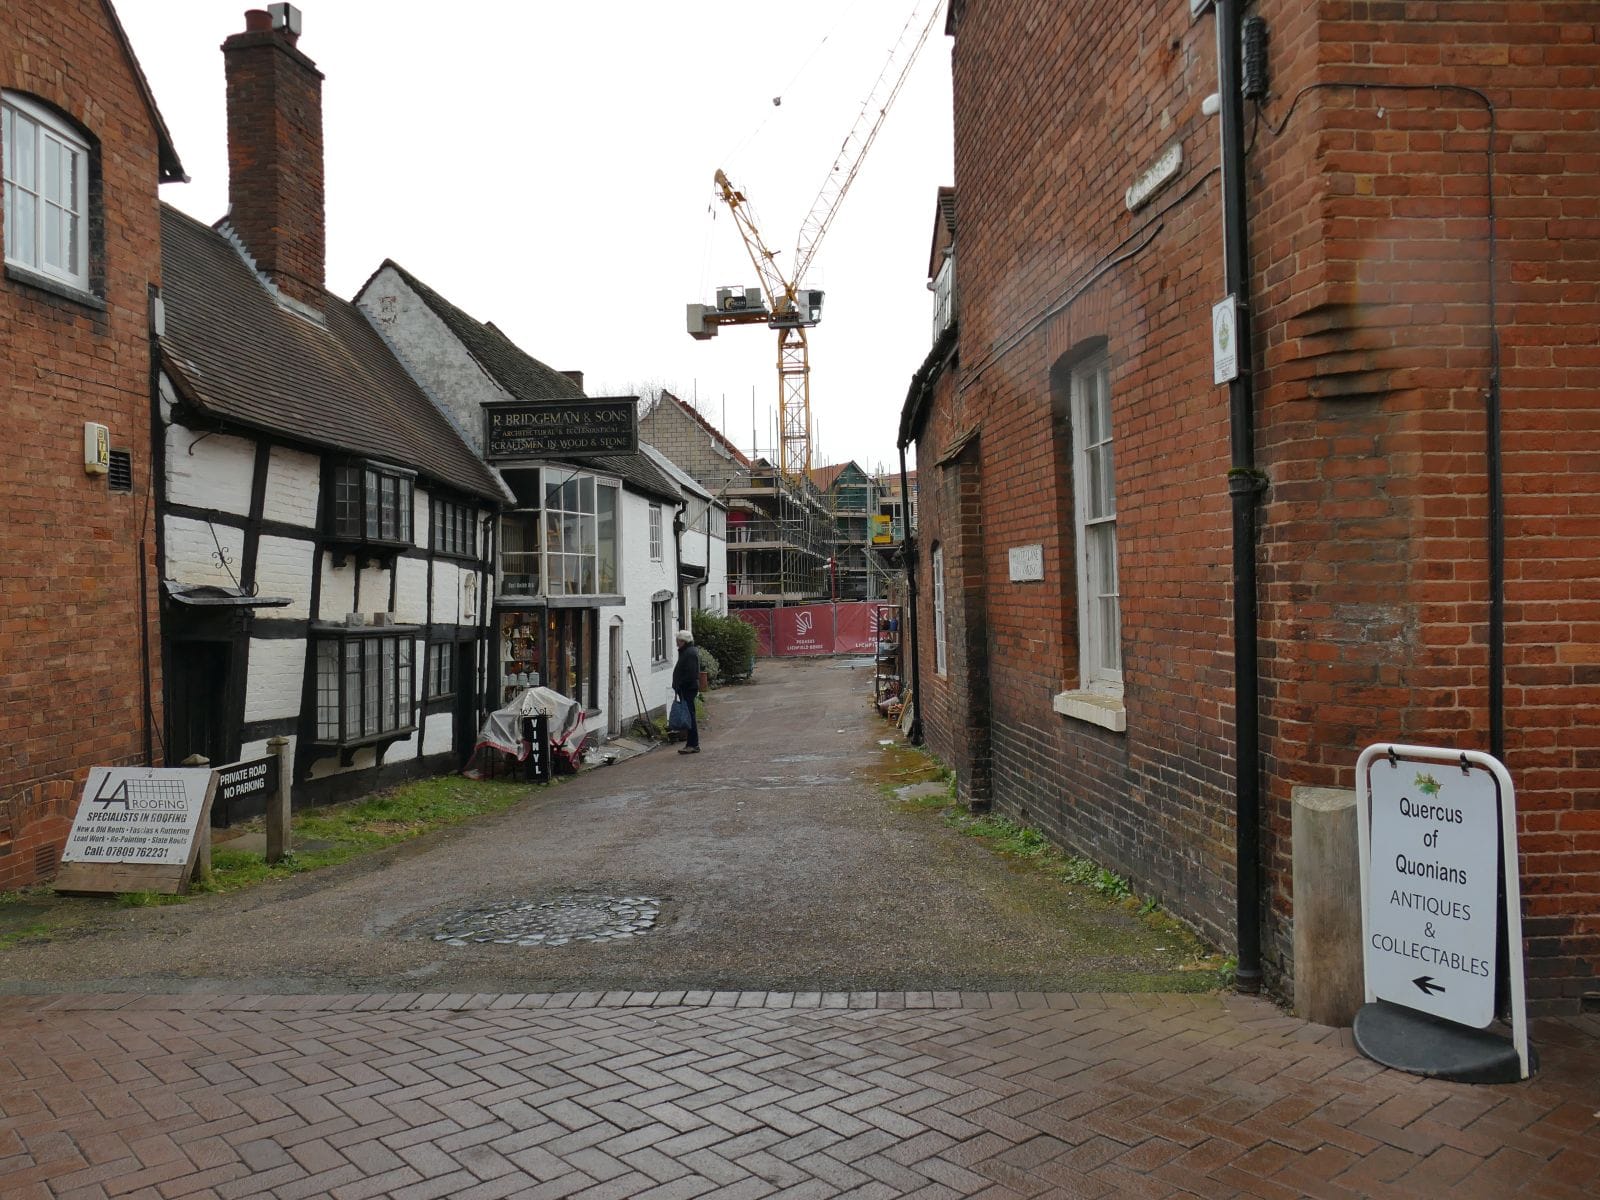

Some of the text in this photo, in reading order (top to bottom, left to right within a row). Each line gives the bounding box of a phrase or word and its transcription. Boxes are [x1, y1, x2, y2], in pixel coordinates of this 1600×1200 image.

[505, 412, 580, 426] BRIDGEMAN
[583, 412, 592, 423] &
[595, 410, 627, 423] SONS
[547, 440, 557, 449] IN
[560, 439, 589, 448] WOOD
[591, 439, 597, 447] &
[531, 719, 541, 774] VINYL
[220, 763, 267, 787] PRIVATE ROAD
[224, 777, 265, 799] NO PARKING
[132, 800, 185, 809] ROOFING
[1400, 797, 1463, 824] Quercus
[87, 812, 187, 823] SPECIALISTS IN ROOFING
[1423, 830, 1438, 848] of
[84, 845, 169, 858] Call: 07809 762231
[1395, 854, 1467, 885] Quonians
[1390, 890, 1471, 921] ANTIQUES
[1424, 922, 1435, 938] &
[1371, 933, 1489, 978] COLLECTABLES
